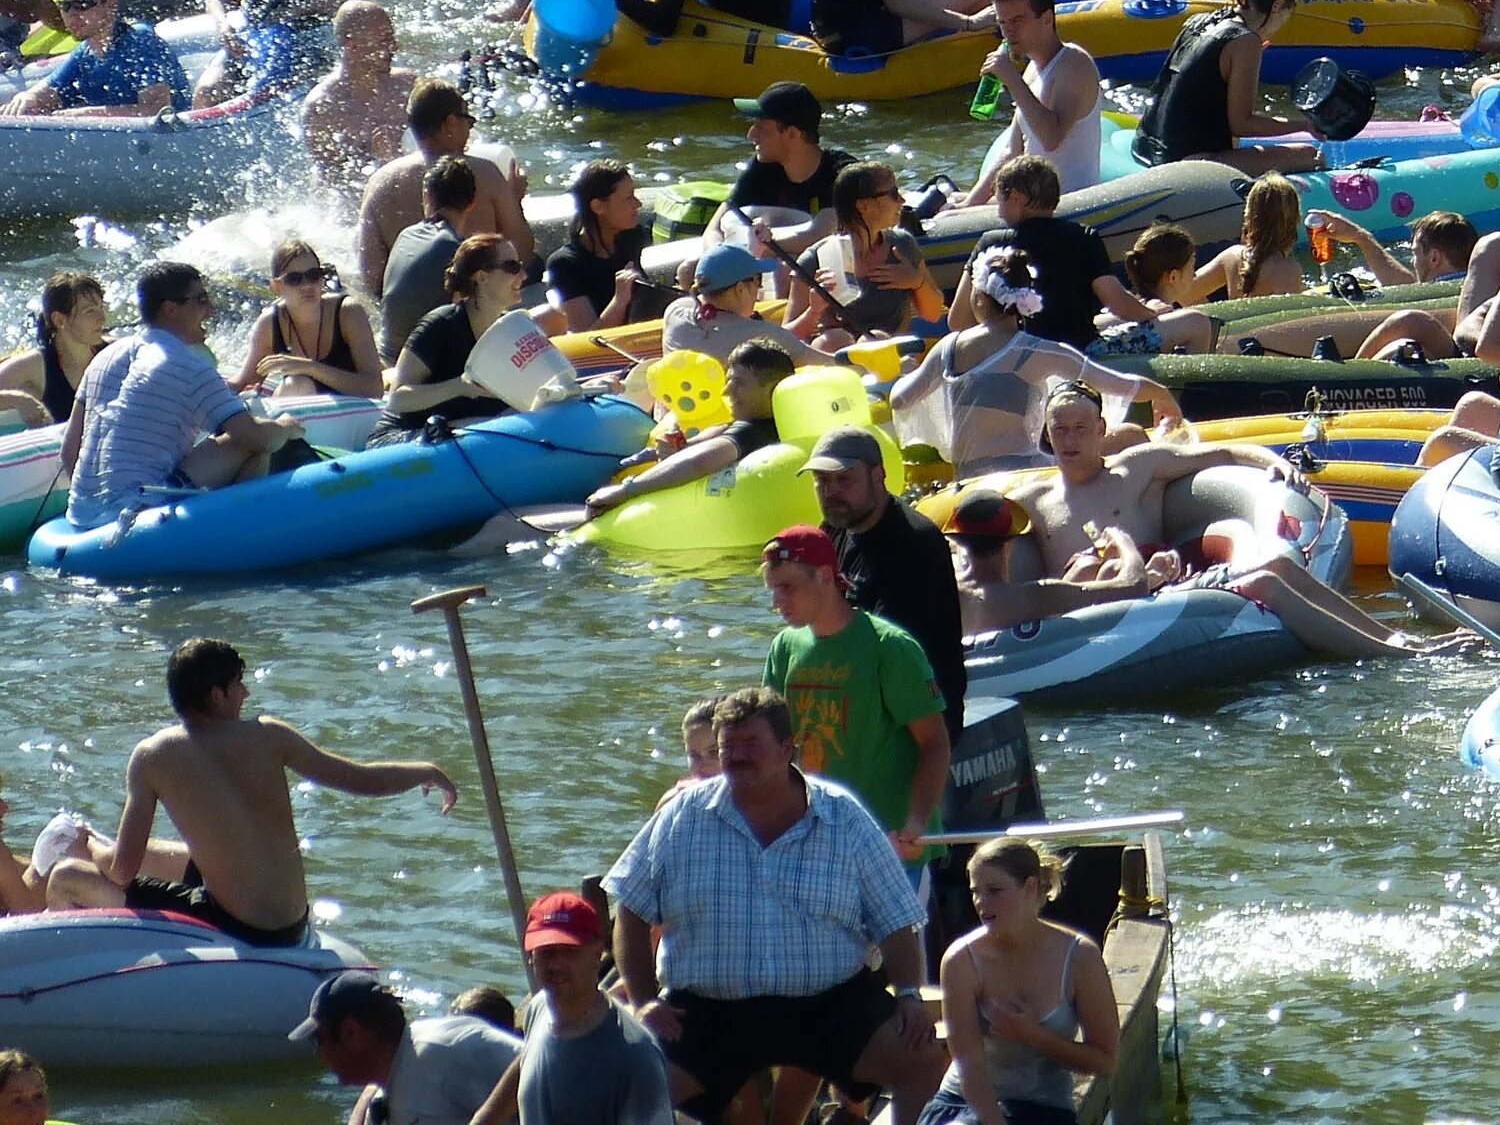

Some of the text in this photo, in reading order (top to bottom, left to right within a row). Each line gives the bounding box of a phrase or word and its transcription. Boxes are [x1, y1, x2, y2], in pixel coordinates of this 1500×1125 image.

[1321, 385, 1428, 409] VOYAGER 500
[948, 744, 1017, 788] YAMAHA
